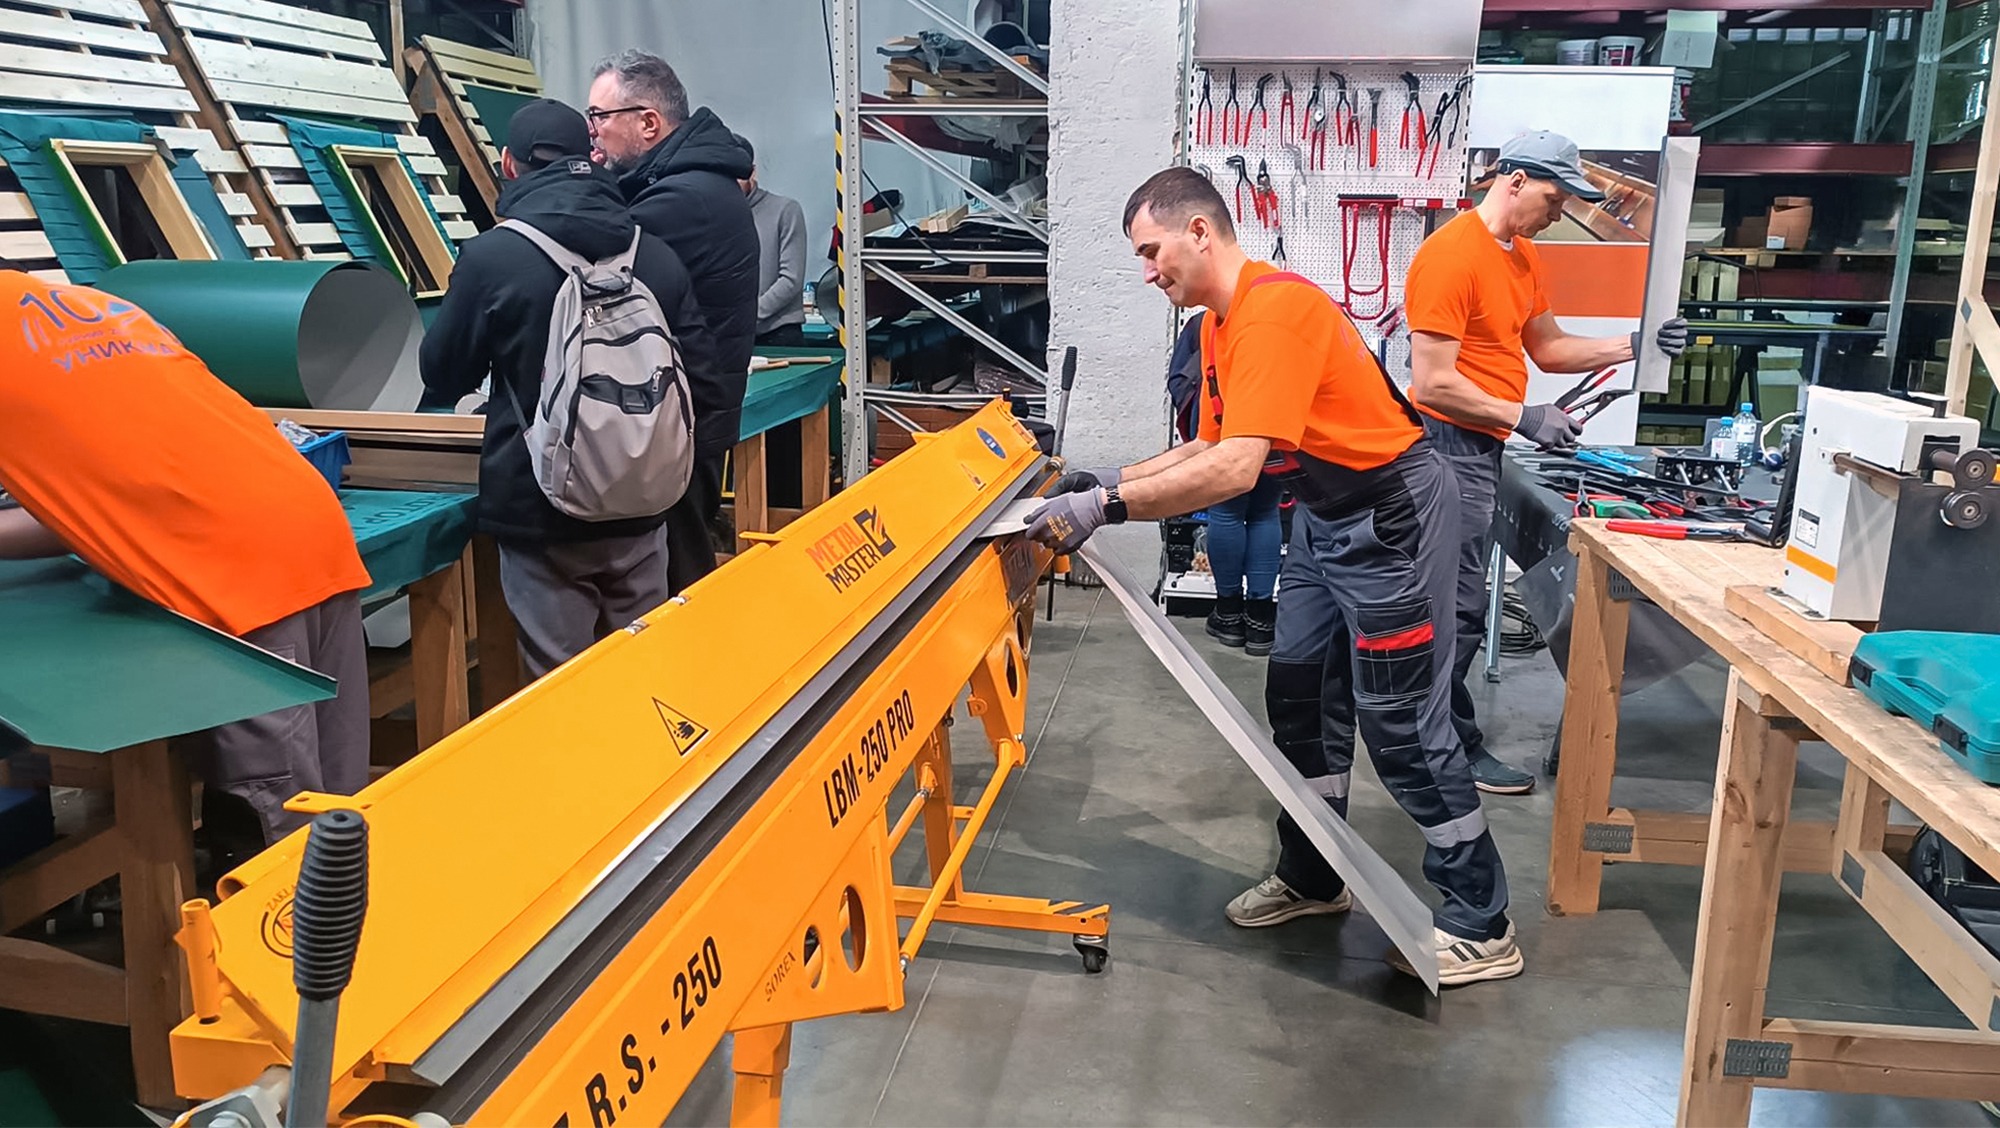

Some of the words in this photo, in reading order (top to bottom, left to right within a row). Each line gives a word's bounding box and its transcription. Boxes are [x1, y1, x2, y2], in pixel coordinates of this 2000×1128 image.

[805, 522, 865, 573] METAL
[825, 543, 882, 594] MASTER
[886, 689, 915, 751] PRO
